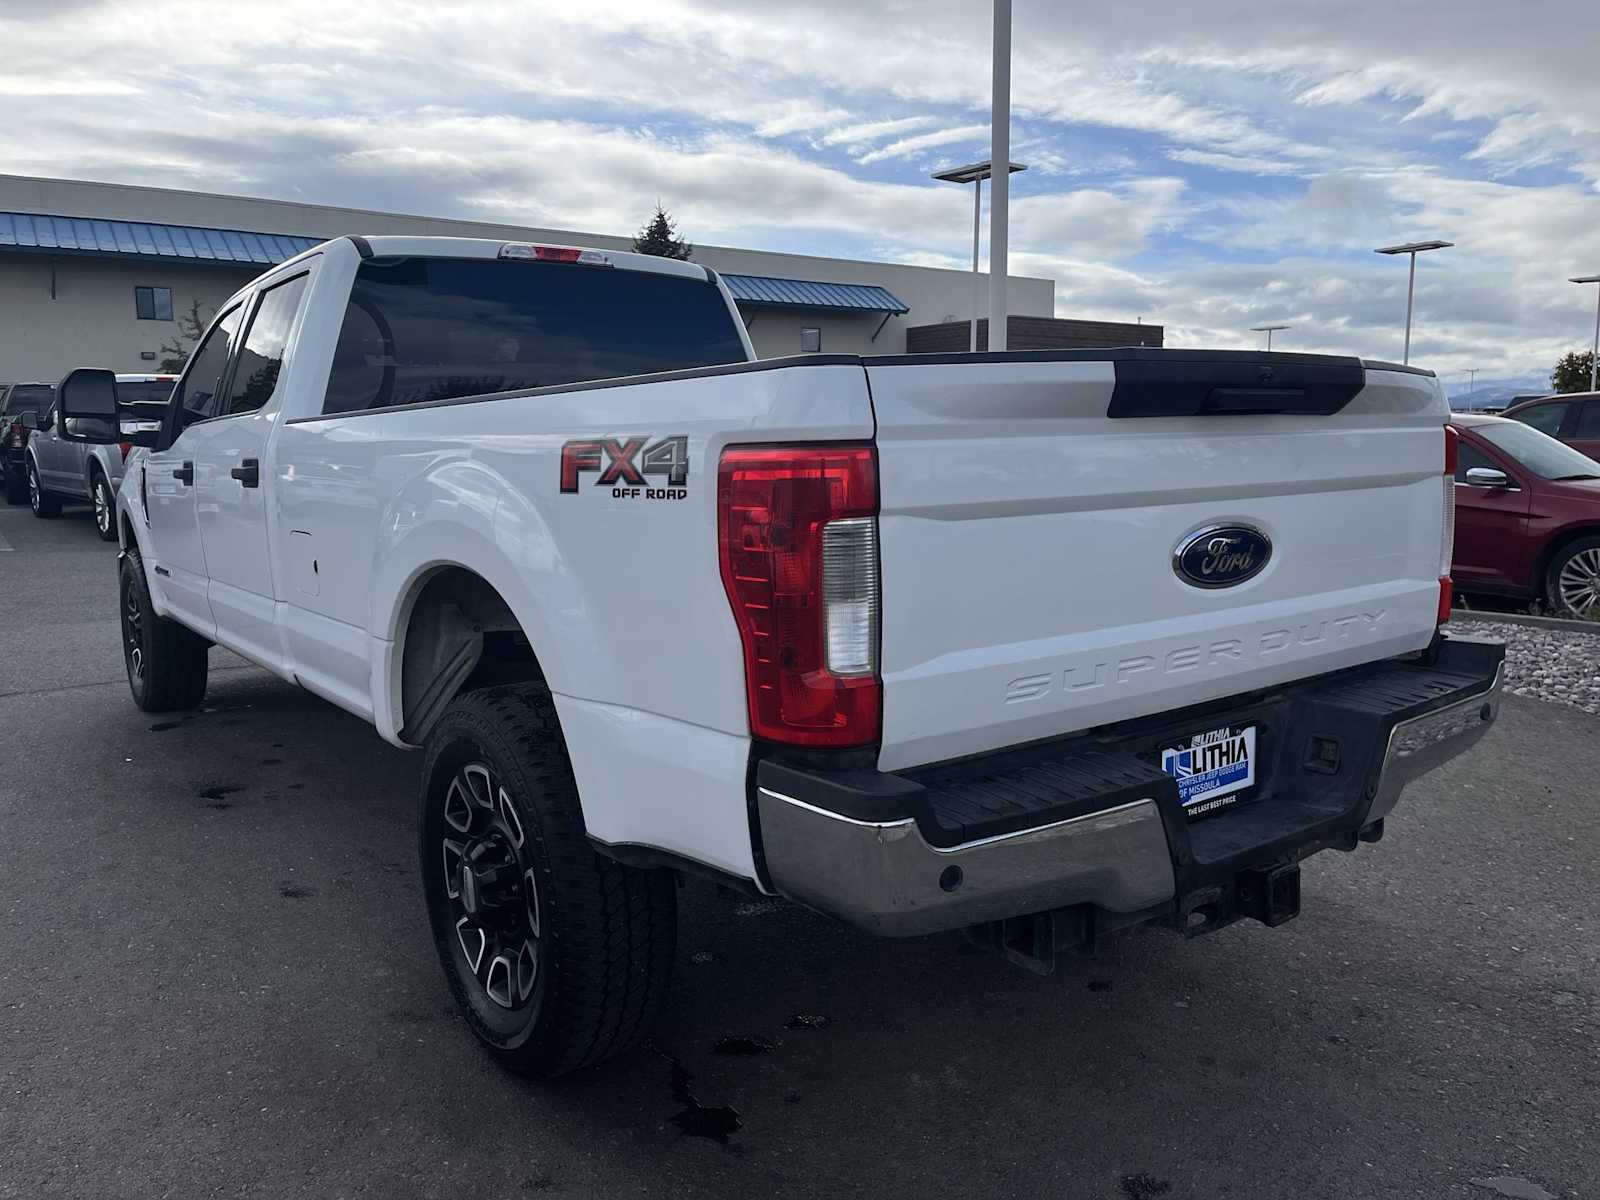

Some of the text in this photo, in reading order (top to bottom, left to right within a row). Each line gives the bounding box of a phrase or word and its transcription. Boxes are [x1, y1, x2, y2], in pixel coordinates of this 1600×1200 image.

[560, 436, 689, 494] FX4
[612, 488, 688, 500] OFF ROAD
[1200, 537, 1254, 575] Ford
[1004, 608, 1388, 705] SUPER DUTY
[1200, 727, 1230, 745] LITHIA
[1192, 736, 1249, 774] LITHIA
[1189, 778, 1221, 795] MISSOULA
[1188, 795, 1236, 816] THE LAST BEST PRICE
